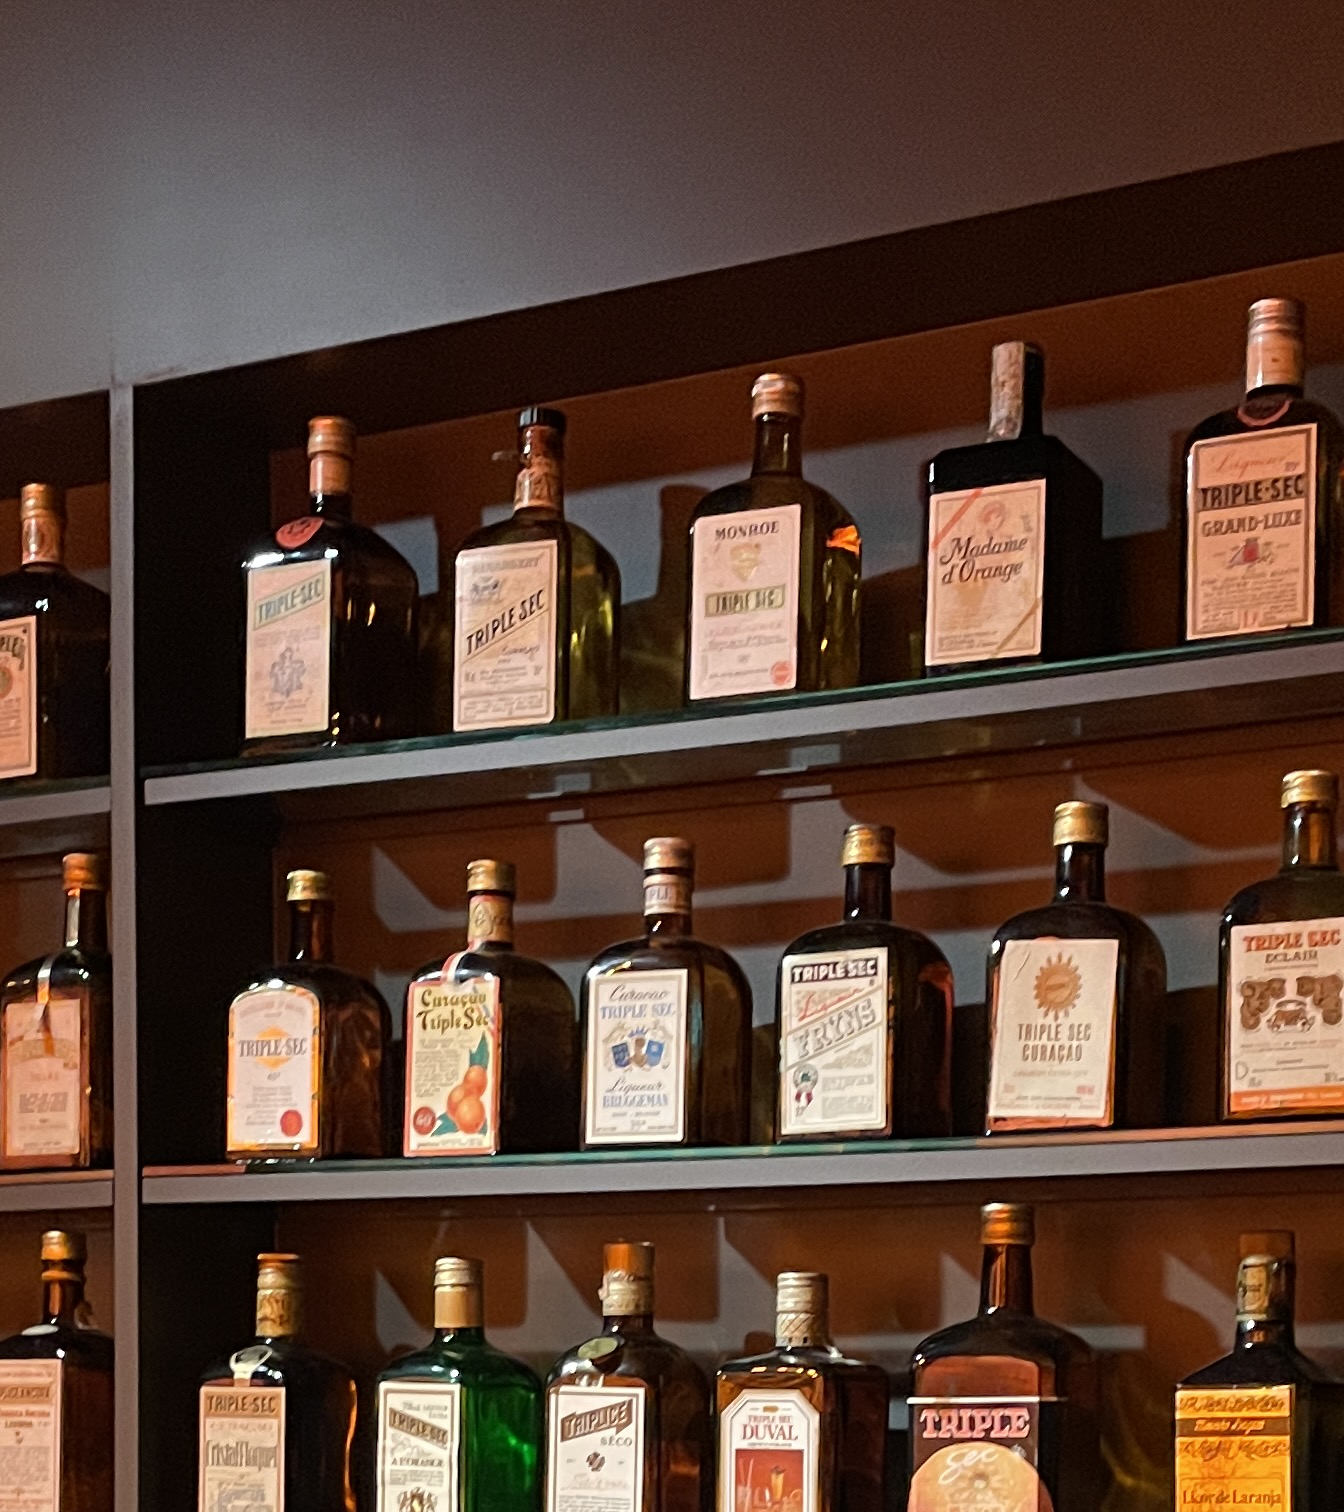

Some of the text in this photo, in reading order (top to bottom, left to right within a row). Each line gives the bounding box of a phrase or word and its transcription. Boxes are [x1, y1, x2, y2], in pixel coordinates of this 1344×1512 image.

[714, 520, 781, 542] MONROE
[1202, 509, 1303, 537] GRAND-LUXE
[940, 535, 1029, 566] Madame
[942, 558, 1024, 587] d'Orange
[466, 618, 516, 656] TRIPLE
[518, 588, 546, 622] SEC
[1244, 929, 1342, 953] TRIPLE SEC
[792, 960, 876, 983] TRIPLE SEC
[417, 1007, 490, 1037] Triple Sec
[600, 1001, 677, 1021] TRIPLE SEC
[1017, 1021, 1091, 1042] TRIPLE SEC
[1021, 1040, 1083, 1064] CURAÇAO
[565, 1403, 630, 1439] TRIPLICE
[741, 1424, 799, 1441] DUVAL
[920, 1408, 1030, 1439] TRIPLE
[1232, 1491, 1281, 1509] Laranja
